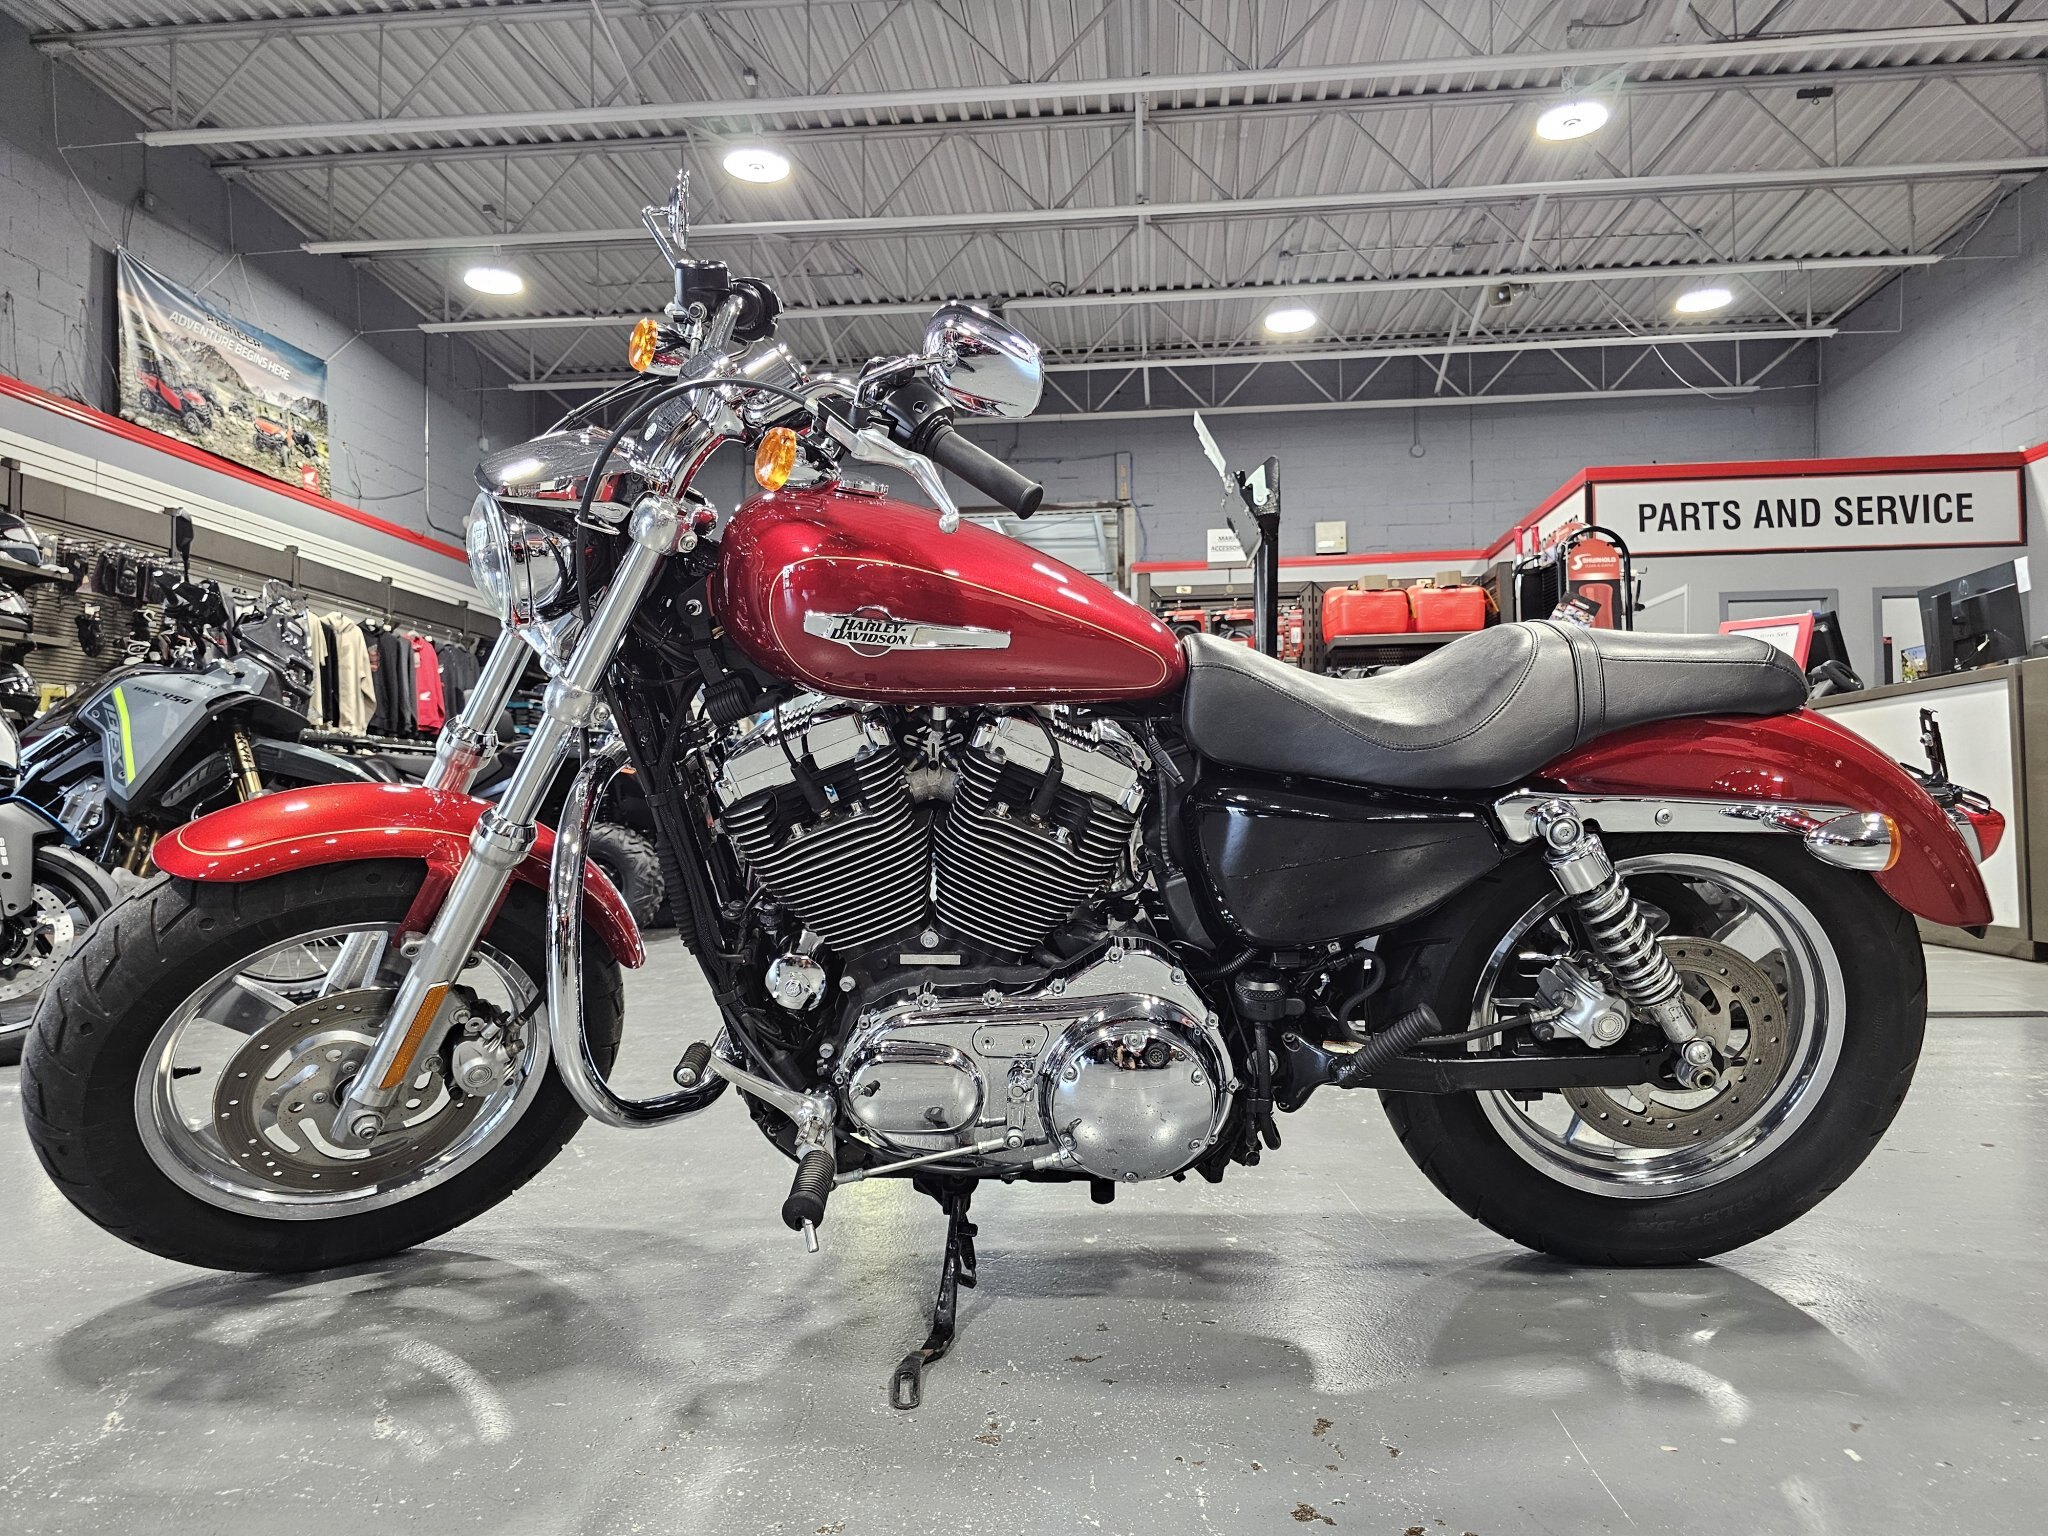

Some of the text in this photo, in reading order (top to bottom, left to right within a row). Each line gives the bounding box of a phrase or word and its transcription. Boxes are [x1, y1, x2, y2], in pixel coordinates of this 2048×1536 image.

[169, 311, 291, 381] ADVENTURE BEGINS HERE
[1638, 493, 1974, 532] PARTS AND SERVICE
[840, 618, 907, 634] HARLEY-
[830, 628, 908, 645] DAVIDSON
[162, 693, 194, 705] 450
